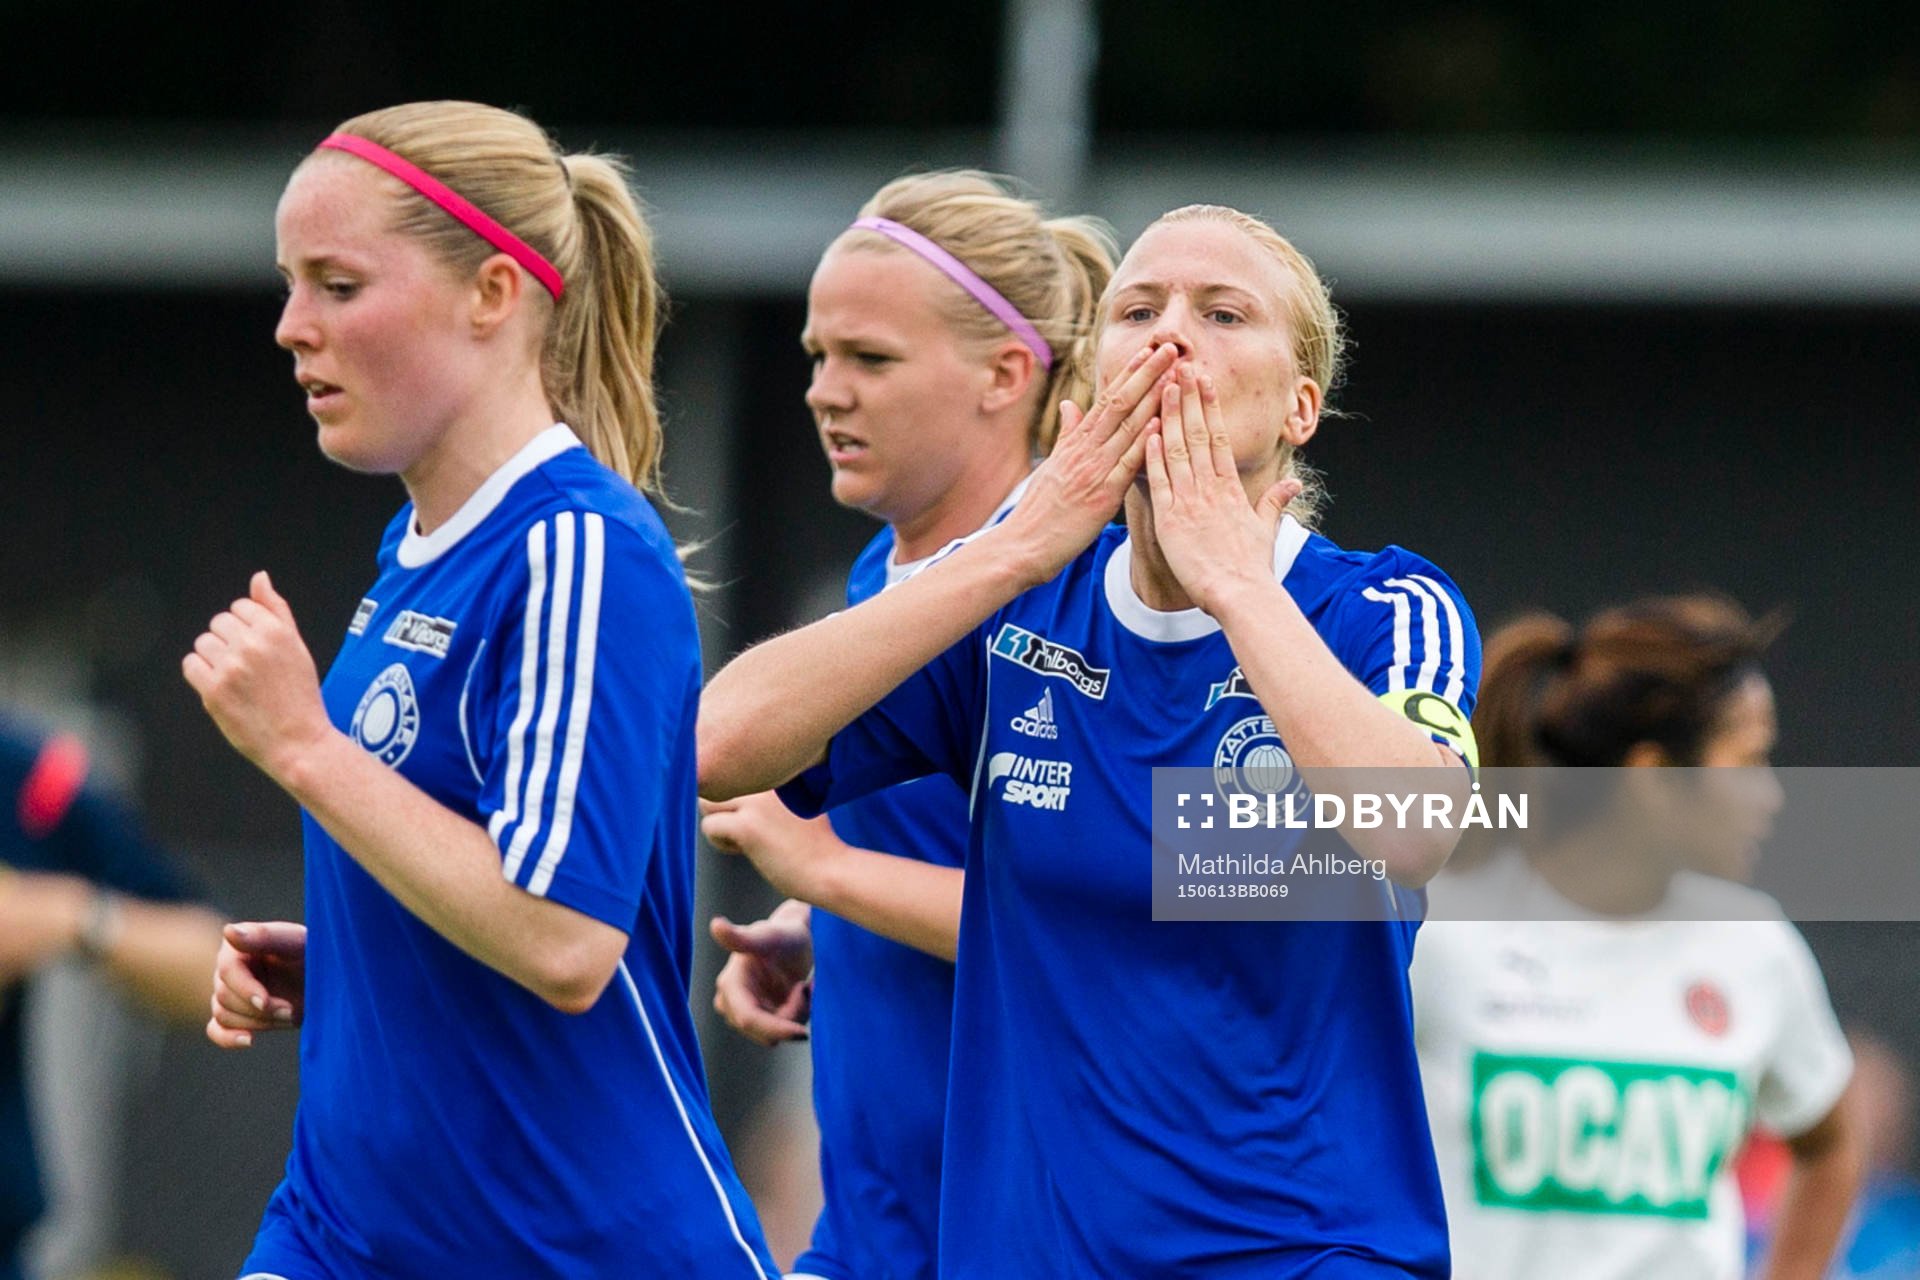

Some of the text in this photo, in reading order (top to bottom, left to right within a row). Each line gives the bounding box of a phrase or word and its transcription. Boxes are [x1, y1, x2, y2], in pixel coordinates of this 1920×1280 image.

[1010, 717, 1058, 739] adidas
[1404, 692, 1461, 737] C
[1219, 720, 1277, 784] STATTE
[1012, 756, 1072, 786] INTER
[1002, 780, 1071, 811] SPORT
